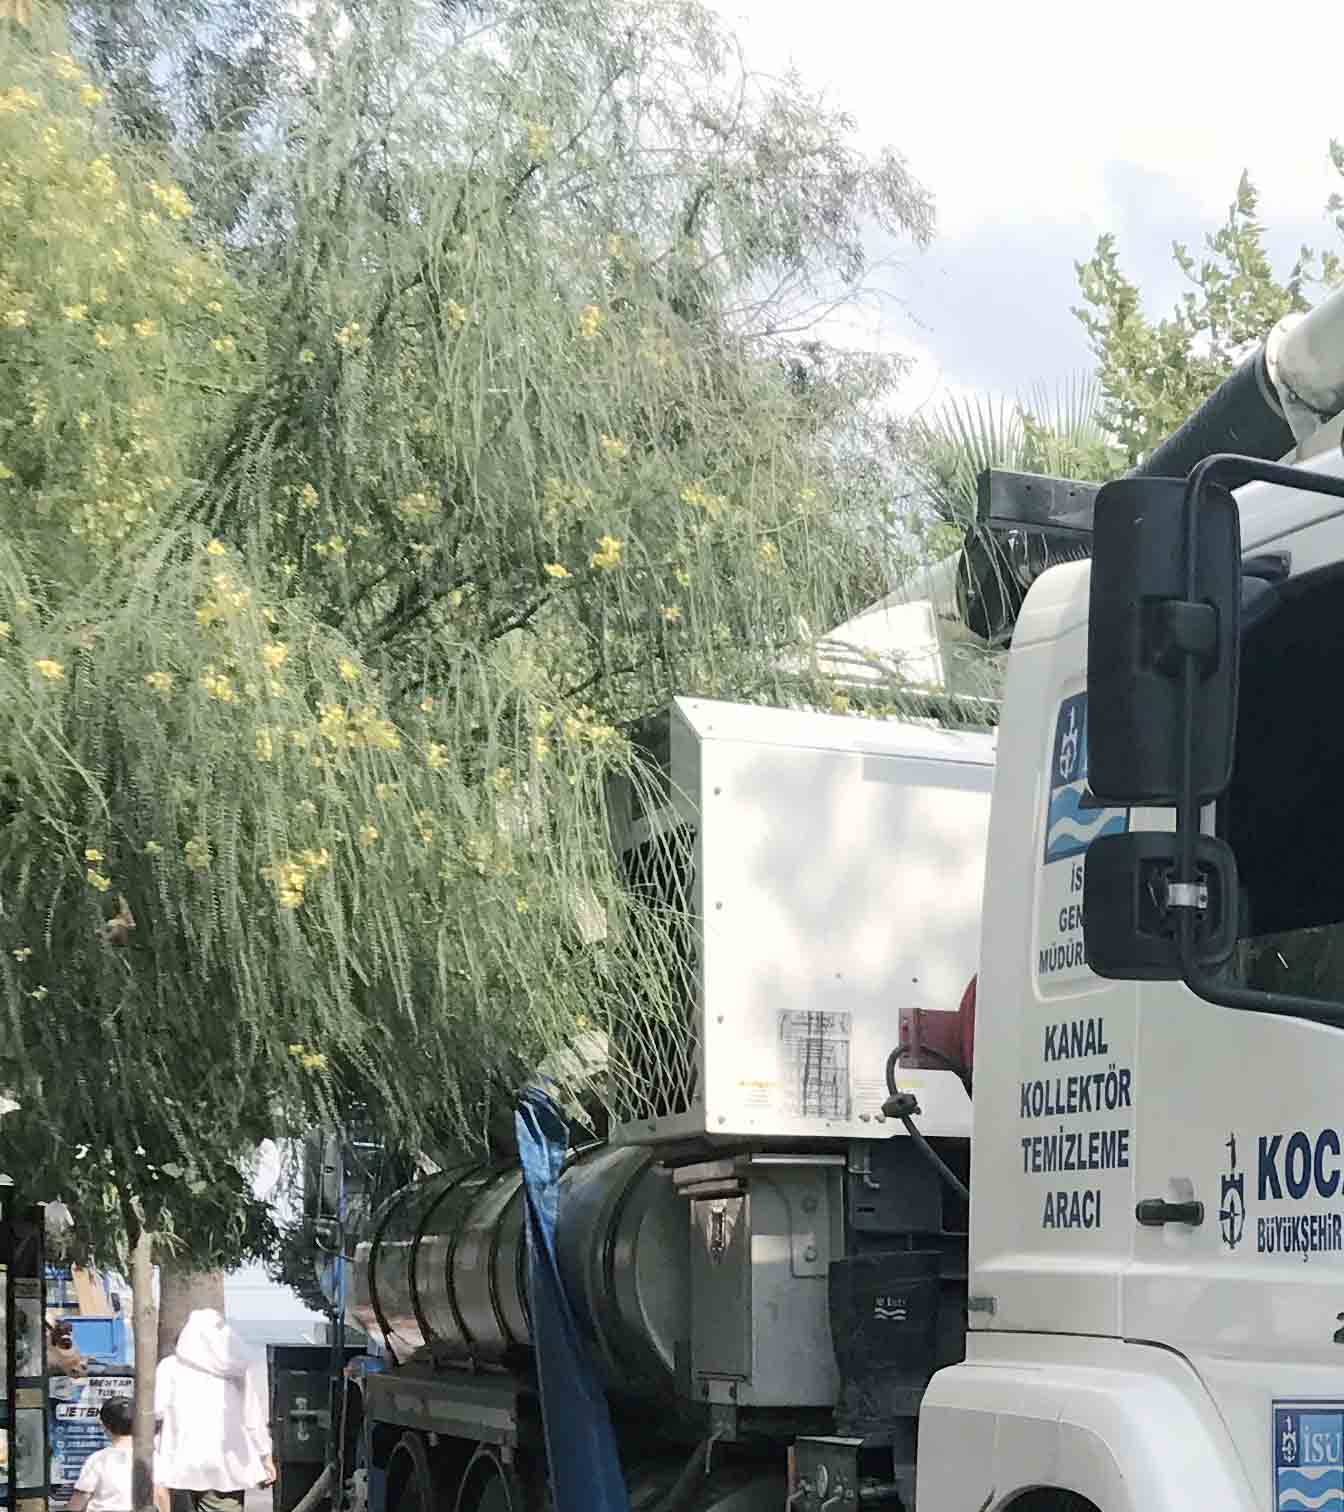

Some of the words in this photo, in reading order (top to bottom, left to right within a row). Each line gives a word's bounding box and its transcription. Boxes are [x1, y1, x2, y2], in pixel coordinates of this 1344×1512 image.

[1059, 903, 1083, 933] GEN
[1039, 940, 1086, 975] MÜDÜR
[1043, 1017, 1109, 1062] KANAL
[1020, 1063, 1132, 1118] KOLLEKTÖR
[1021, 1125, 1130, 1173] TEMİZLEME
[1042, 1190, 1102, 1229] ARACI
[1257, 1212, 1343, 1263] BÜYÜKŞEHİR
